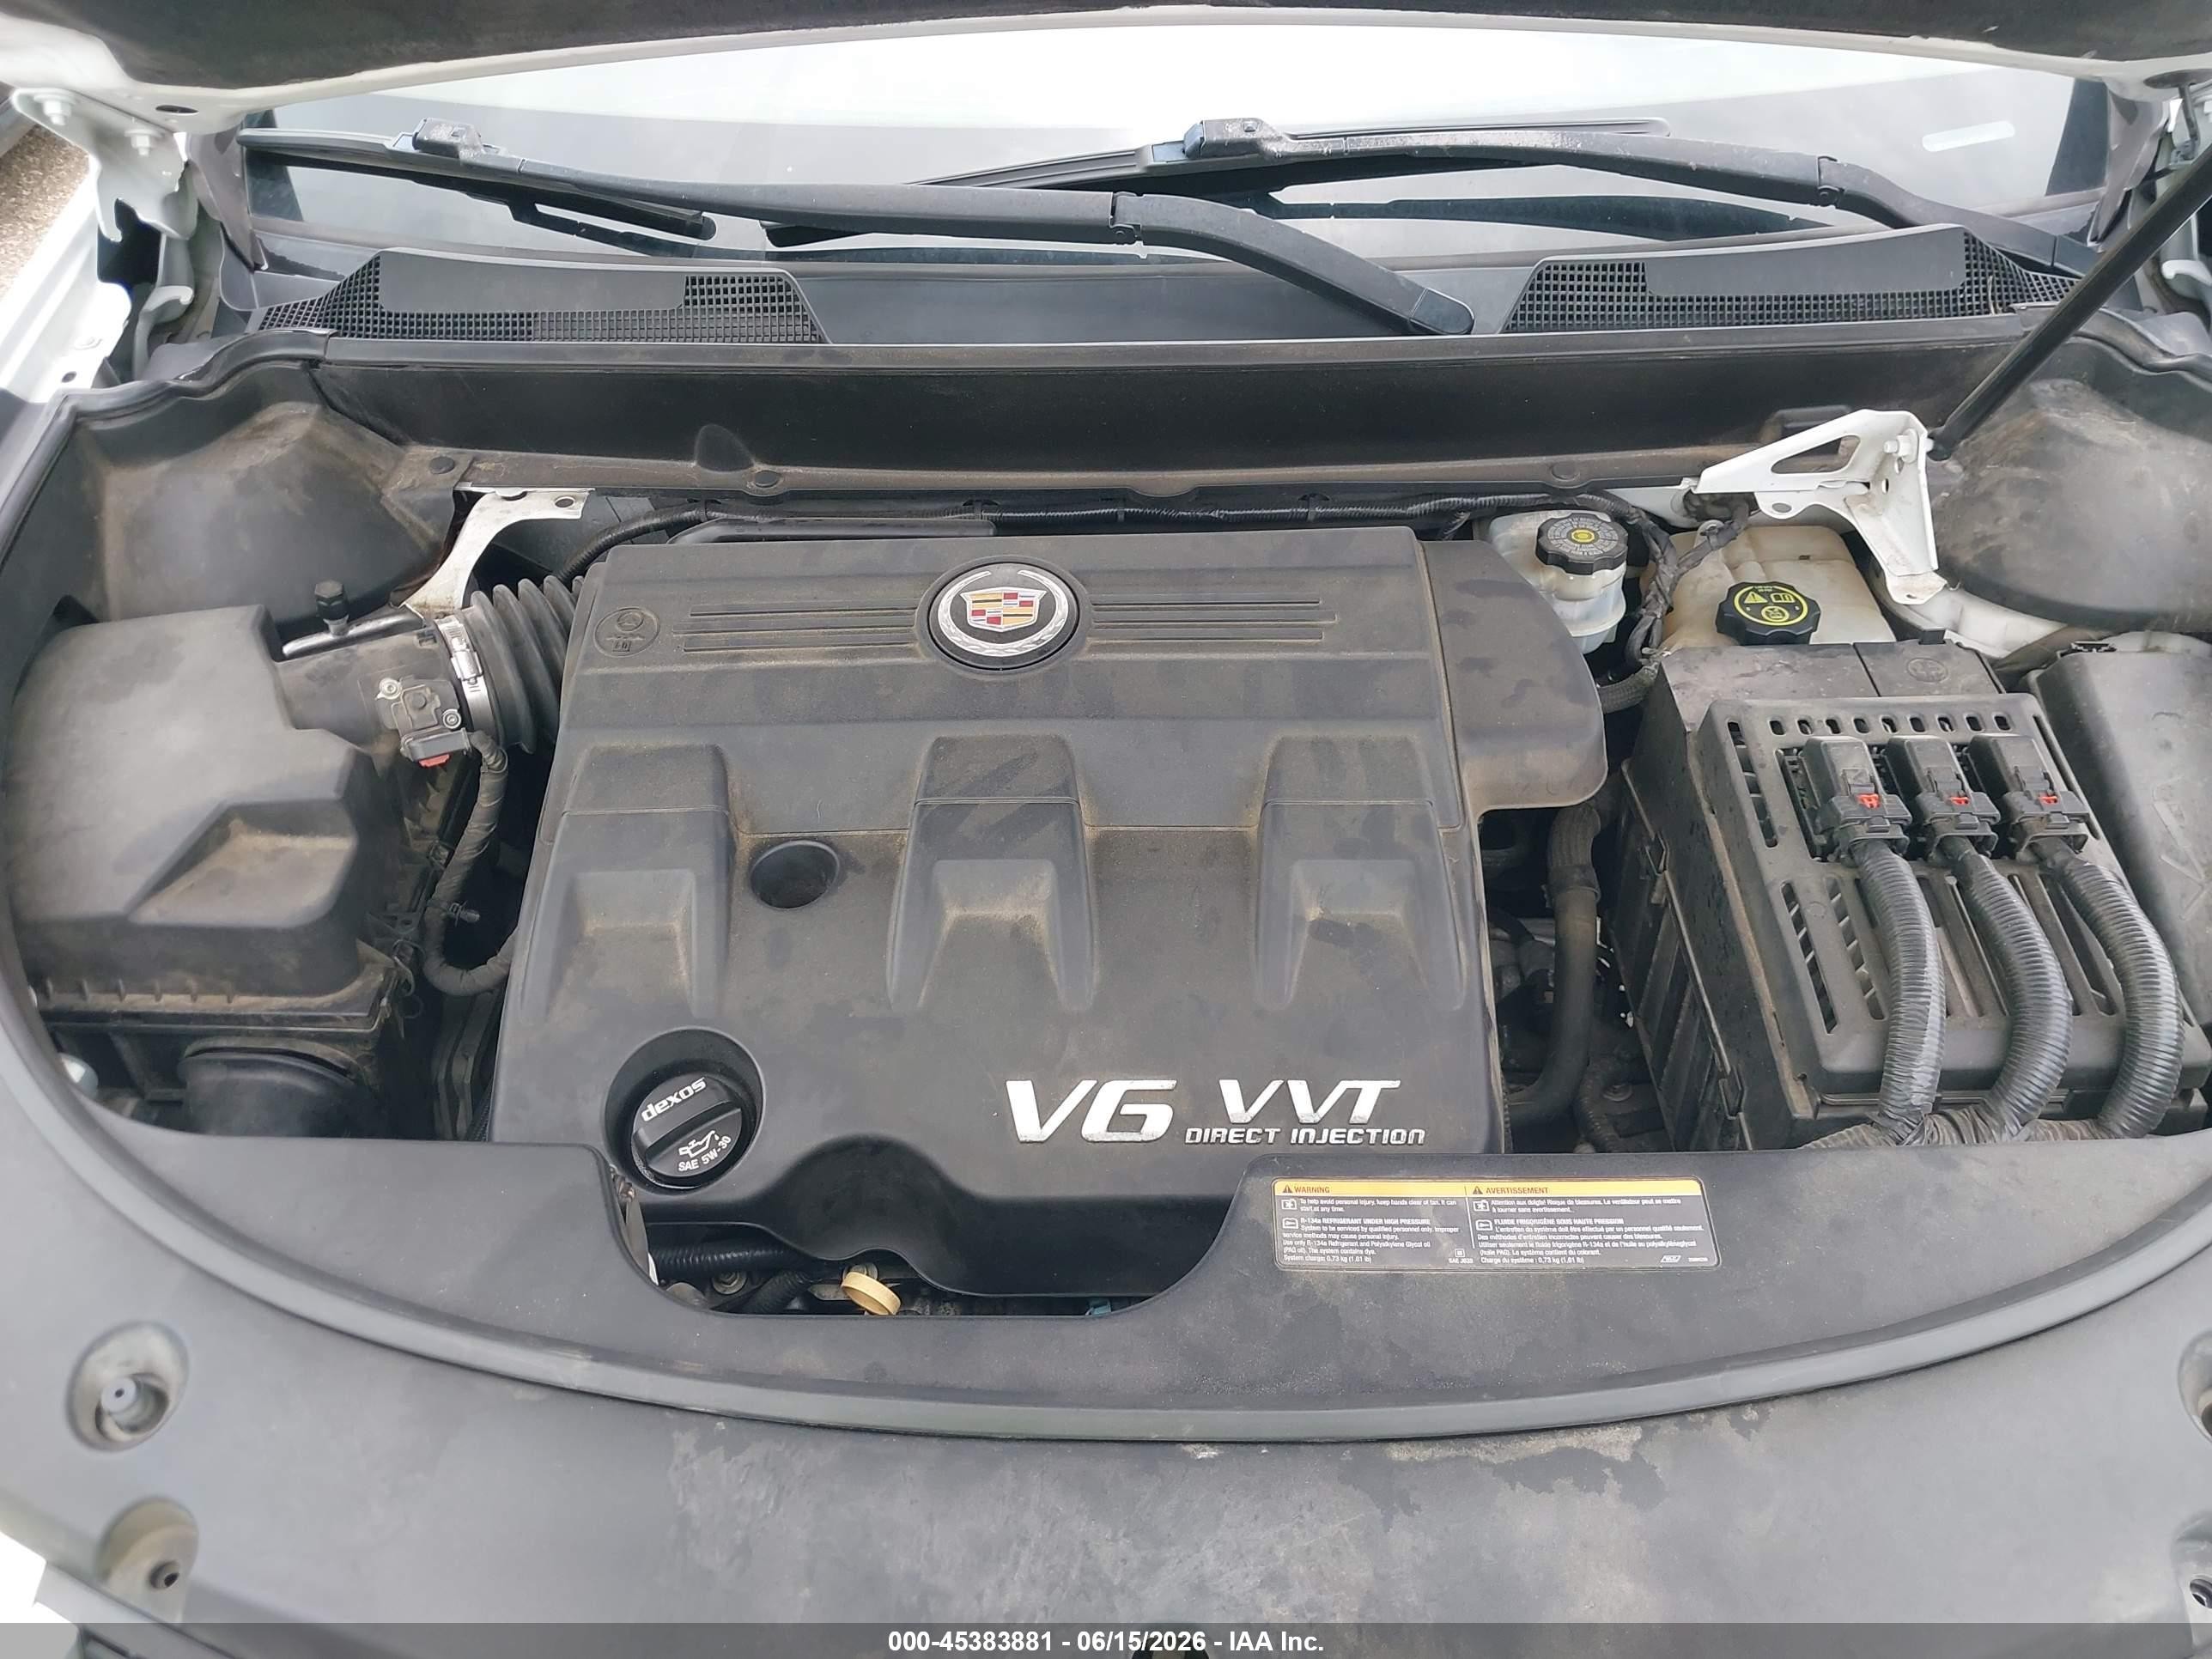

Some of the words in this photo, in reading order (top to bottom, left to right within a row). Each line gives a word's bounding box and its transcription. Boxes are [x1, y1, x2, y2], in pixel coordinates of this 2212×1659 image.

[641, 1077, 707, 1121] dexos
[1006, 1079, 1177, 1143] V6
[1218, 1079, 1401, 1125] VVT
[678, 1160, 700, 1172] SAE
[701, 1135, 732, 1164] 5W-30
[1185, 1127, 1281, 1145] DIRECT
[1290, 1127, 1426, 1146] INJECTION
